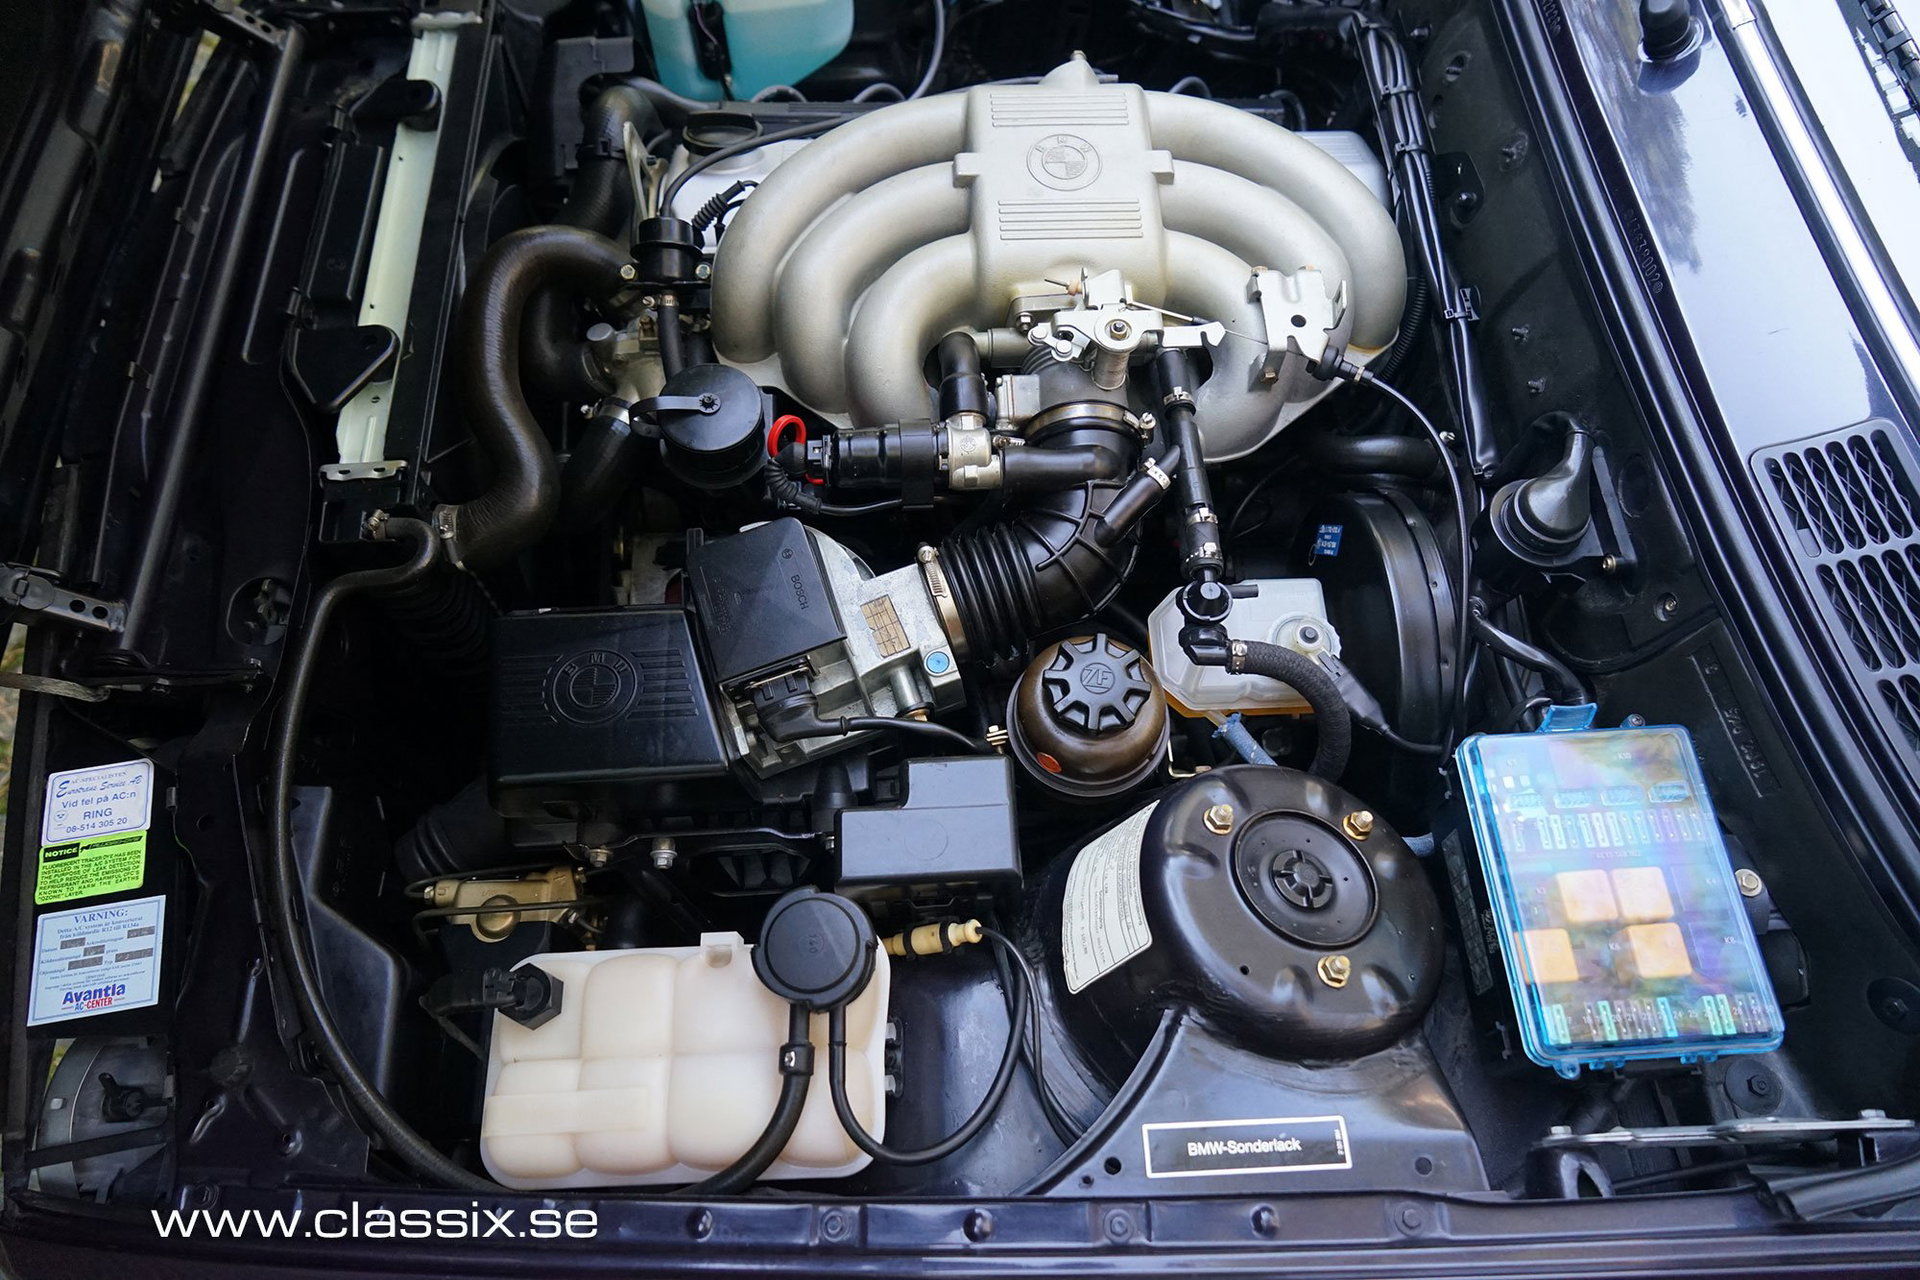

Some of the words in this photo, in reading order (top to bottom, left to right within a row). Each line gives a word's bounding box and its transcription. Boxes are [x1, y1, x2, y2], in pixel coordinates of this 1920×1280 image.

[790, 574, 809, 611] BOSCH
[562, 652, 629, 678] BMW
[1083, 668, 1113, 686] ZF
[62, 800, 78, 808] Vid
[96, 795, 108, 805] på
[112, 792, 136, 800] AC:n
[84, 808, 112, 820] RING
[66, 823, 95, 833] 08-514
[99, 819, 114, 828] 305
[117, 817, 127, 825] 20
[45, 848, 77, 857] NOTICE
[75, 909, 127, 923] VARNING:
[63, 984, 125, 1004] Avantia
[75, 997, 112, 1010] AC-CENTER
[1187, 1138, 1302, 1157] BMW-Sonderlack
